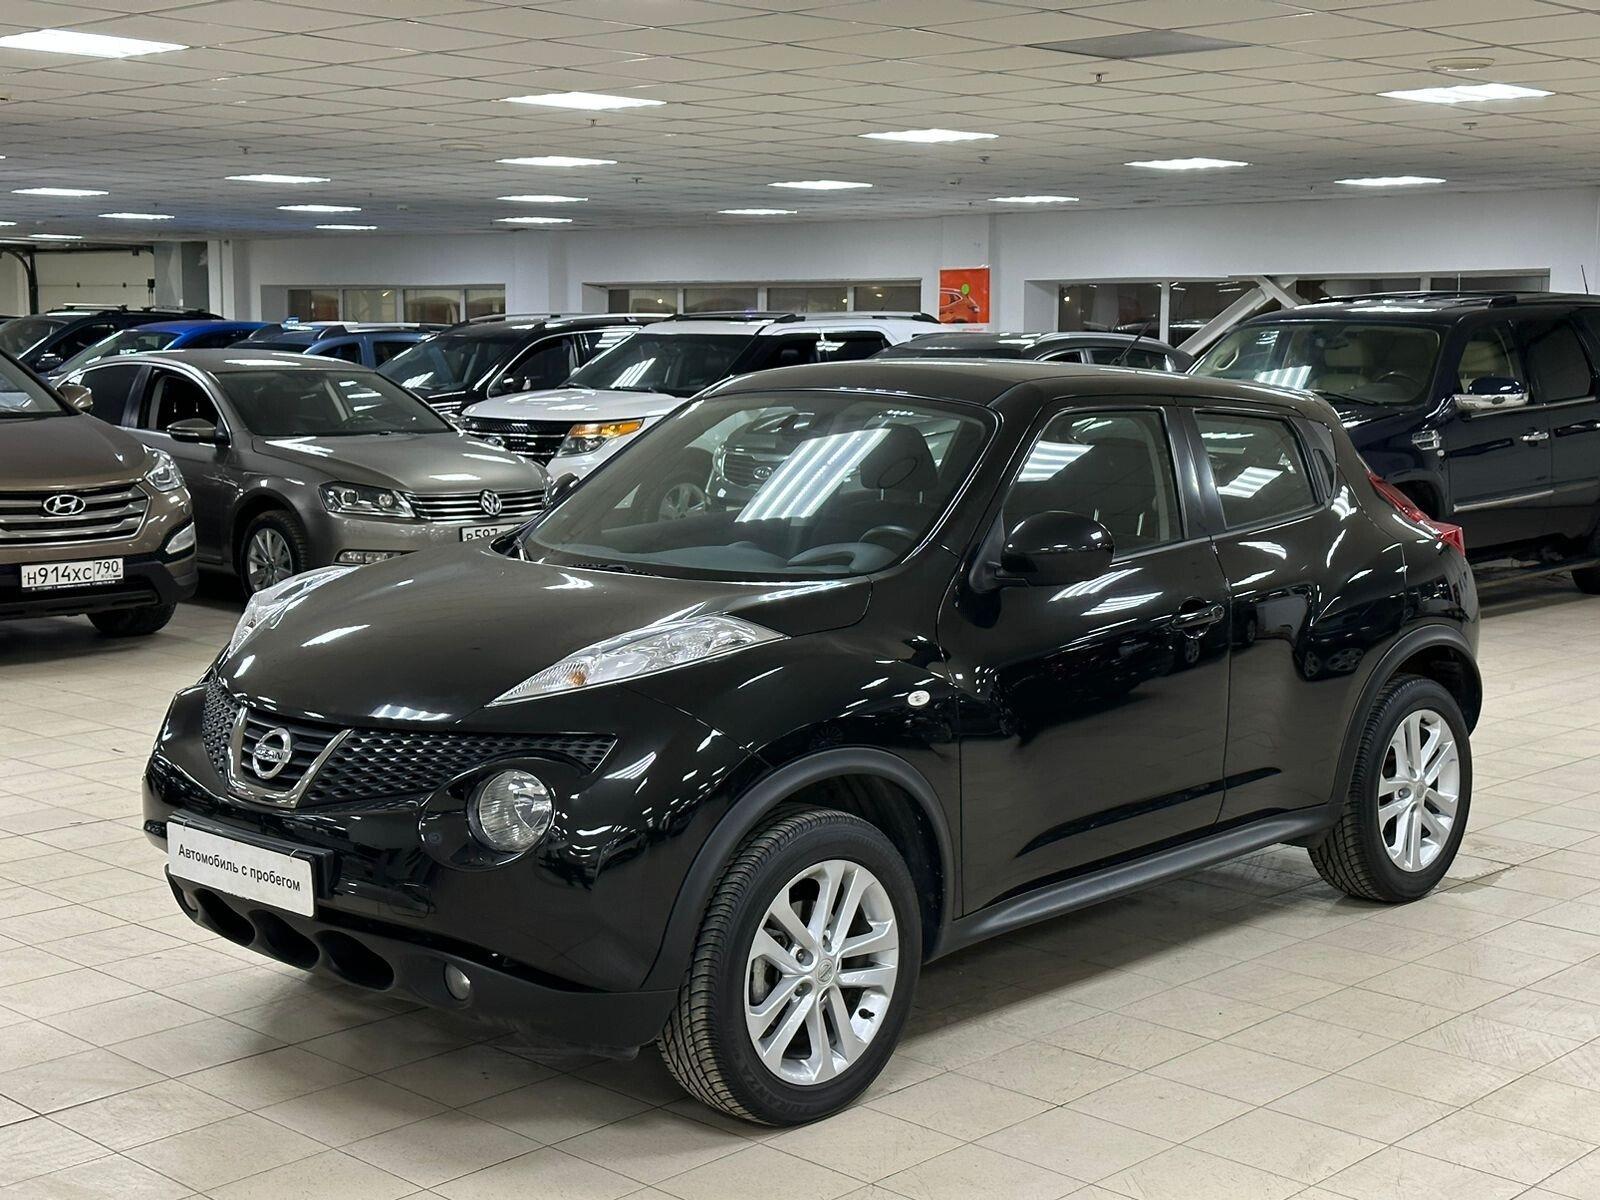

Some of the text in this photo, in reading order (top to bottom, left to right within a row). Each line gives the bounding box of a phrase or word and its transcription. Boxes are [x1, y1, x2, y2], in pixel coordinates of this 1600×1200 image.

[27, 565, 92, 585] Н914ХС
[95, 560, 119, 575] 790
[178, 843, 301, 892] Автомобиль с пробегом
